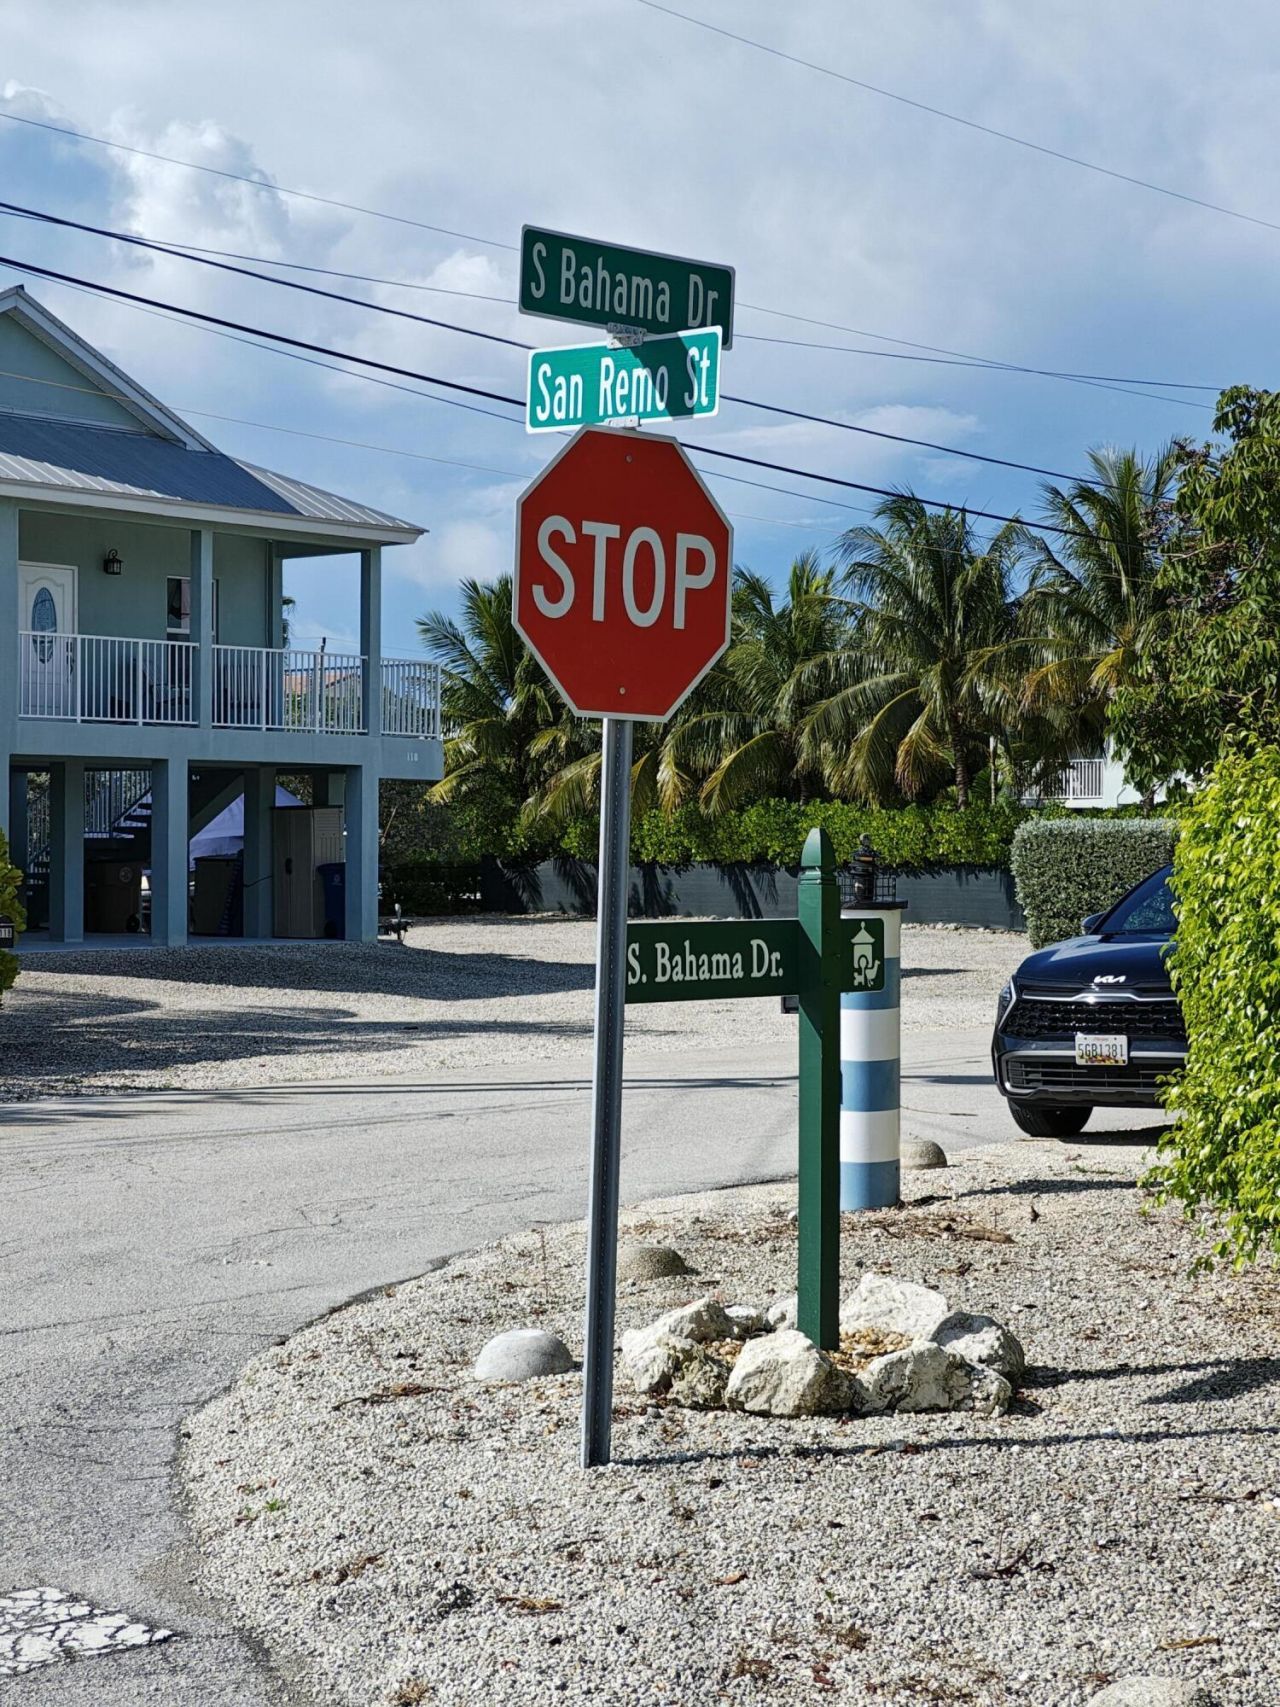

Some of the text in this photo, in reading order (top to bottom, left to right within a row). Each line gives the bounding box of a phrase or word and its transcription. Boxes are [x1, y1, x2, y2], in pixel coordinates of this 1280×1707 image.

[530, 241, 719, 327] S Bahama Dr
[536, 346, 710, 421] San Remo St
[532, 515, 716, 630] STOP
[627, 938, 783, 985] S. Bahama Dr.
[1077, 1043, 1124, 1058] 5GB1381
